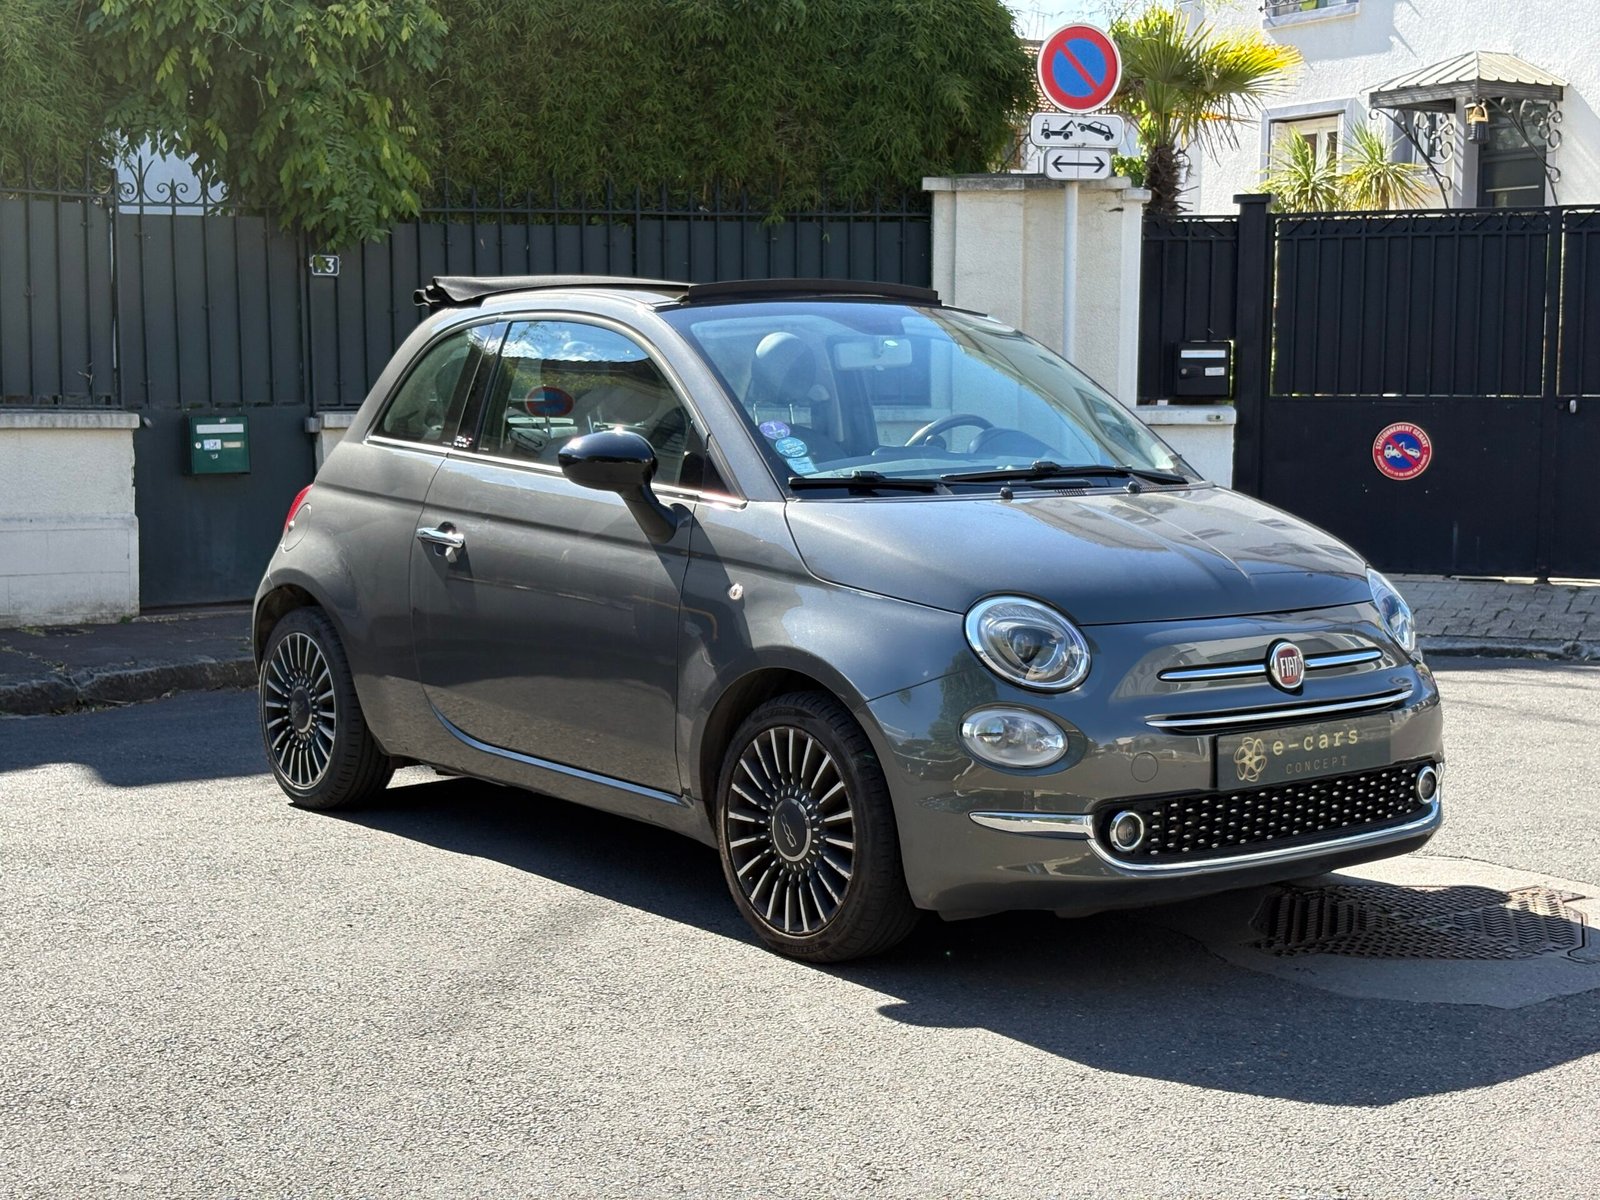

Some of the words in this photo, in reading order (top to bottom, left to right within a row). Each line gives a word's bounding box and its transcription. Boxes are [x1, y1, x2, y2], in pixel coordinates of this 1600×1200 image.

[317, 258, 335, 273] 3
[1280, 656, 1298, 678] FIAT
[1272, 729, 1358, 756] e-cars
[1286, 755, 1348, 775] CONCEPT
